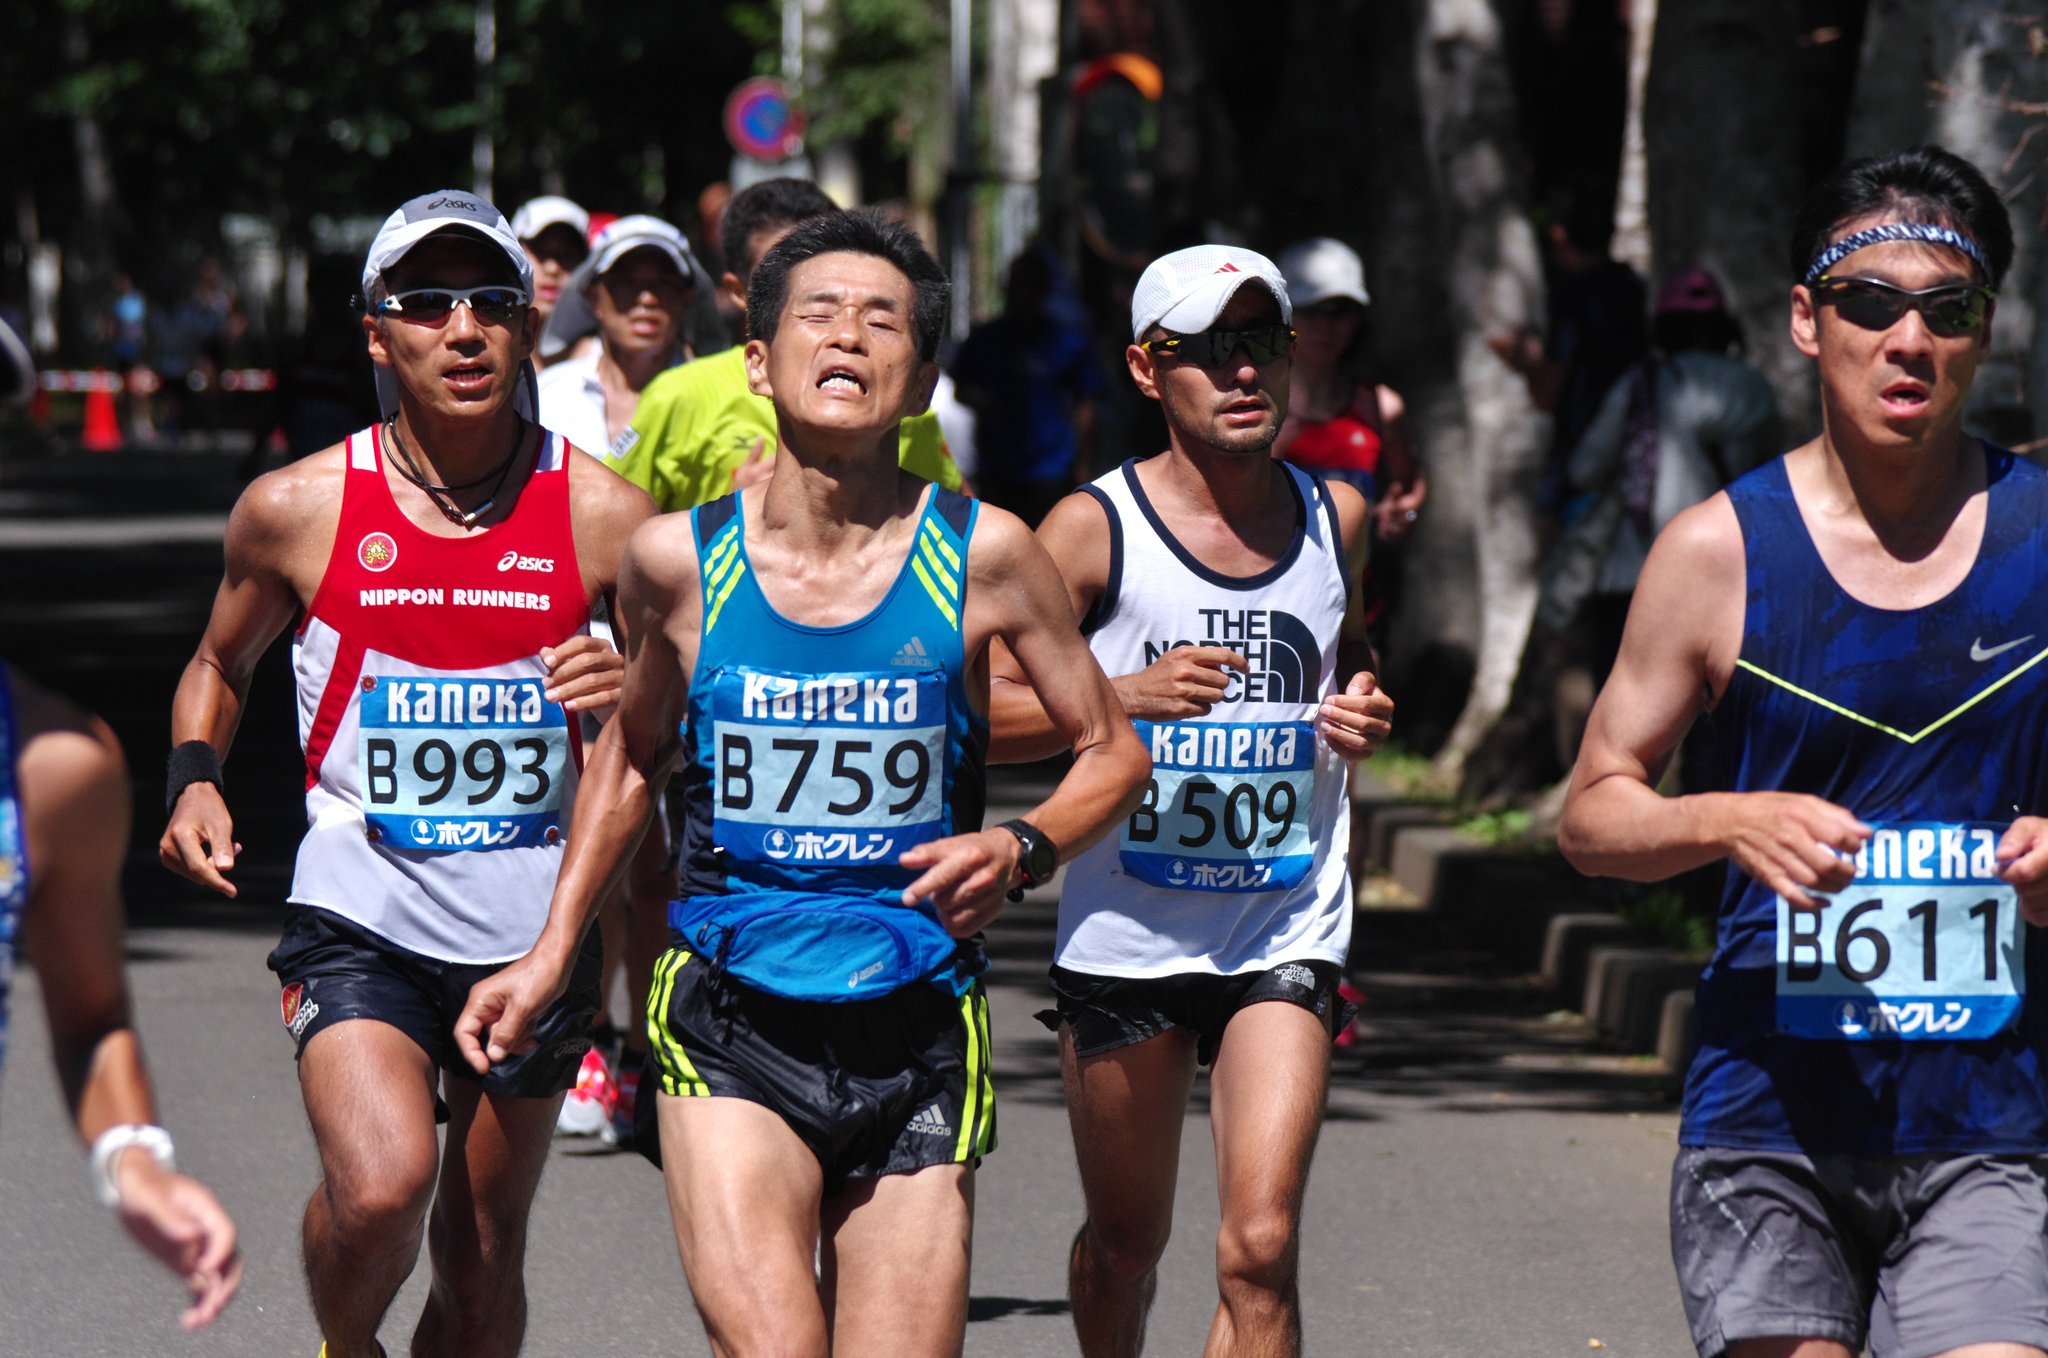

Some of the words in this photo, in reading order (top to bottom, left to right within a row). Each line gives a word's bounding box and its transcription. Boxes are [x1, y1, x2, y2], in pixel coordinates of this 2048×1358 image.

[445, 200, 477, 211] asics
[517, 555, 554, 573] asics
[360, 588, 444, 606] NIPPON
[453, 588, 551, 611] RUNNERS
[1198, 609, 1268, 640] THE
[890, 656, 934, 667] adidas
[1144, 639, 1267, 672] NTH
[436, 821, 520, 846] ホクレン
[794, 832, 894, 861] ホクレン
[1191, 863, 1272, 888] ホクレン
[1274, 968, 1304, 978] NORTH
[1866, 1002, 1972, 1033] ホクレン
[906, 1121, 952, 1136] adidas
